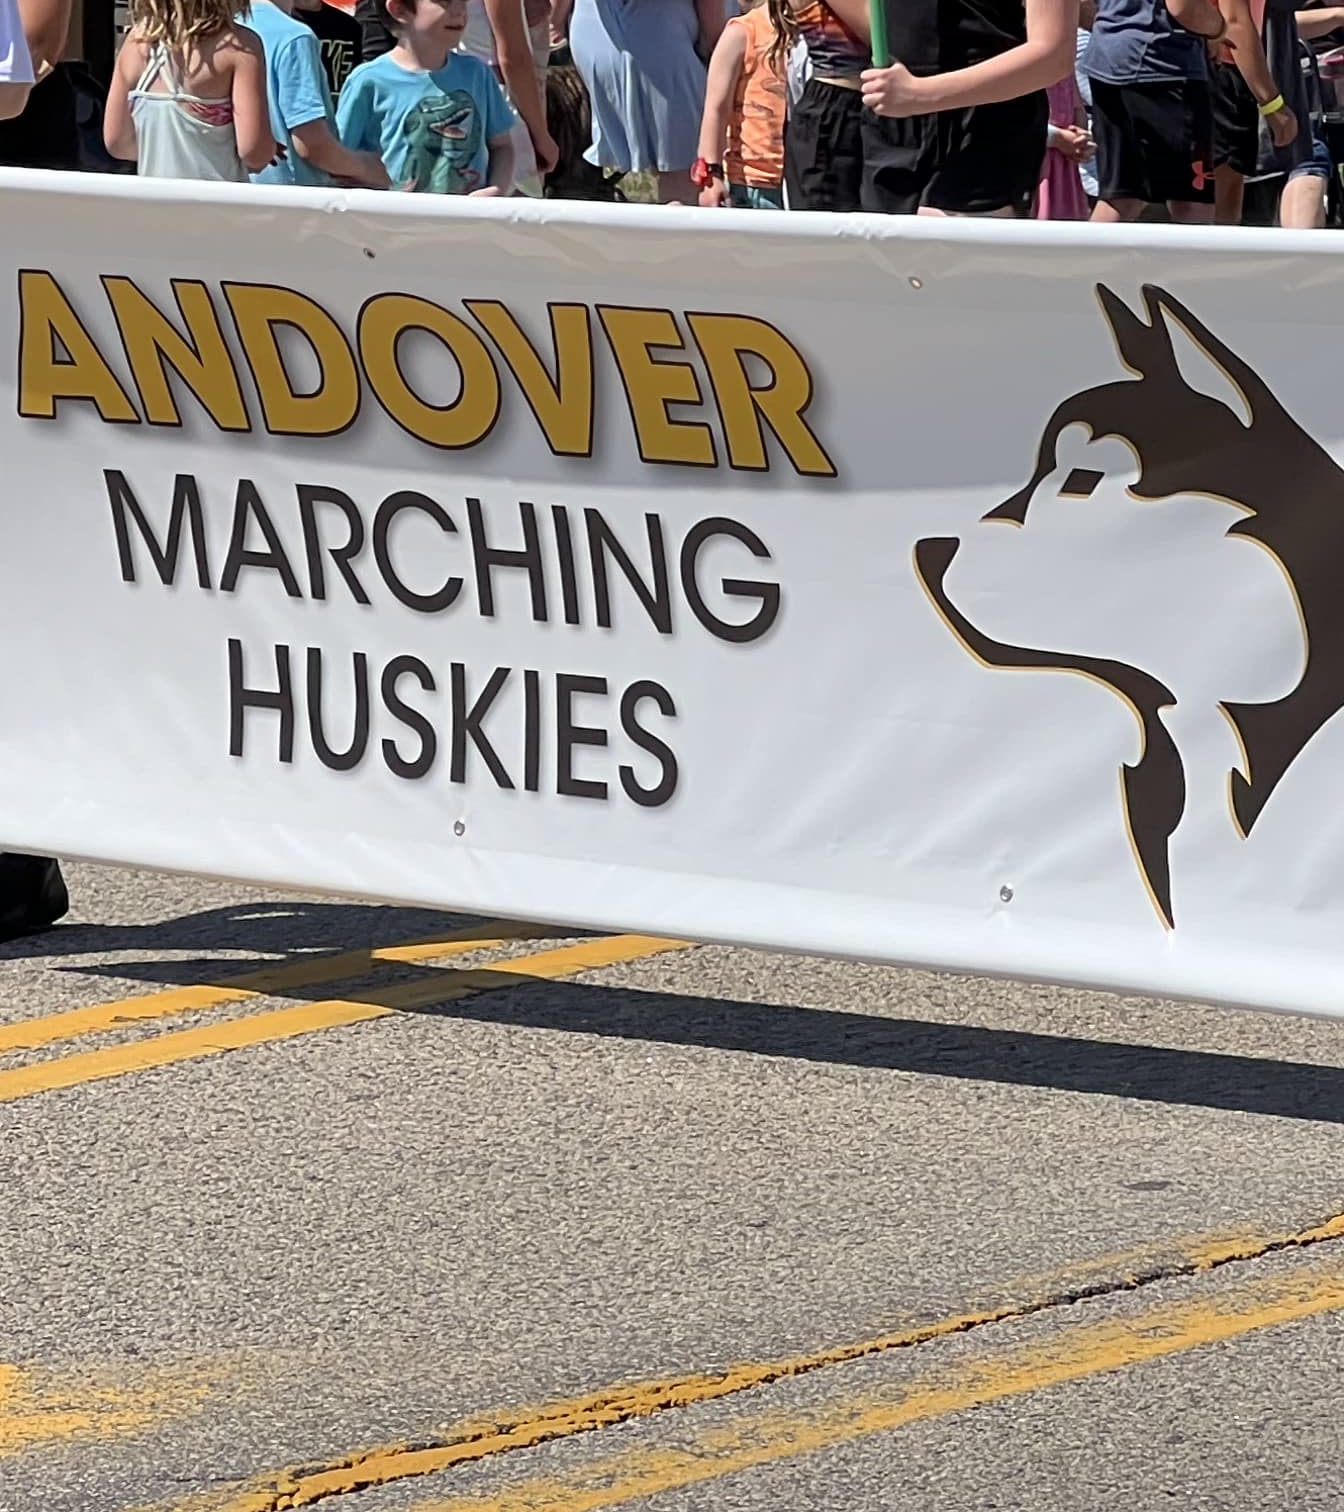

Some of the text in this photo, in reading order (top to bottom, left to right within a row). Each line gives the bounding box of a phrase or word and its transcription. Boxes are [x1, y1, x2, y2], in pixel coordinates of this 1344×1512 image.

[17, 269, 839, 479] ANDOVER
[103, 469, 781, 644] MARCHING
[228, 639, 678, 808] HUSKIES
